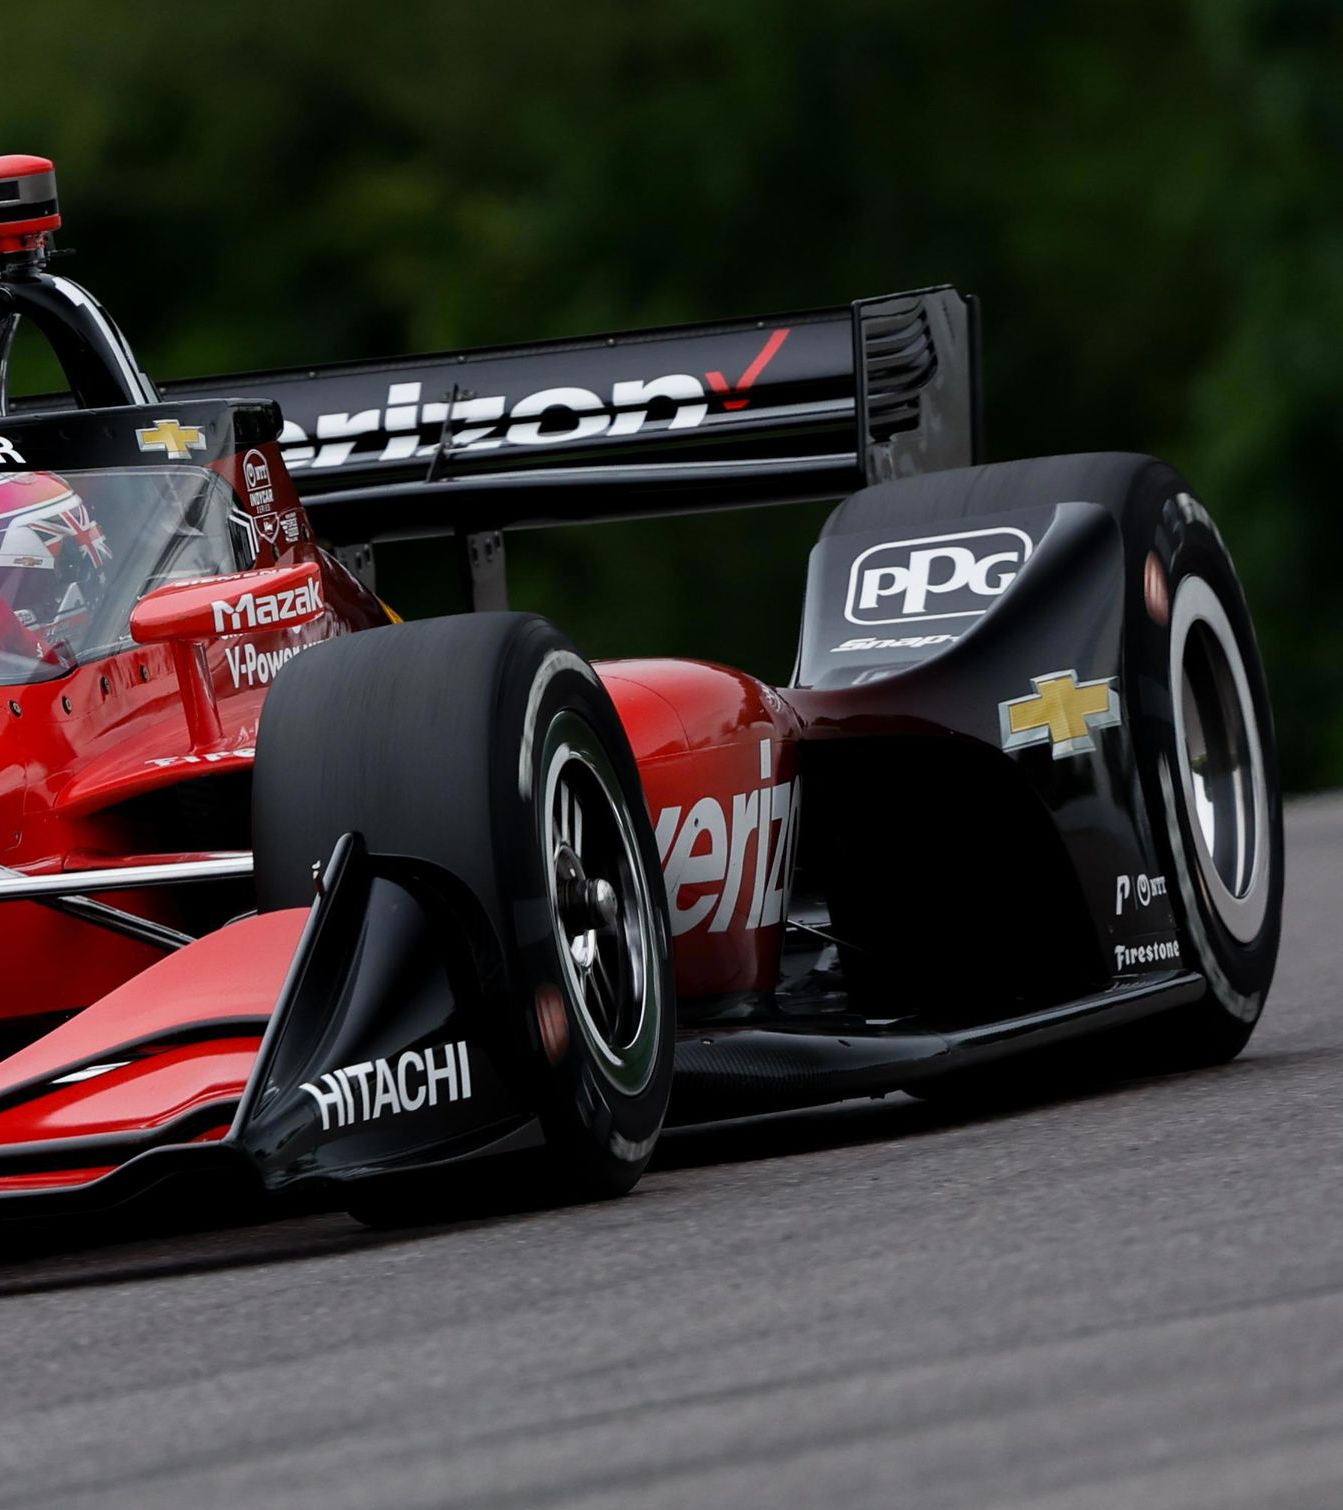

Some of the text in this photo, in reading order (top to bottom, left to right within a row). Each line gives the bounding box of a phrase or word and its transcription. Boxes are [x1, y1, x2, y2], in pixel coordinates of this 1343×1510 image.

[211, 576, 324, 634] Mazak
[859, 546, 1019, 615] PPG
[1114, 940, 1180, 972] Firestone
[298, 1040, 472, 1131] HITACHI
